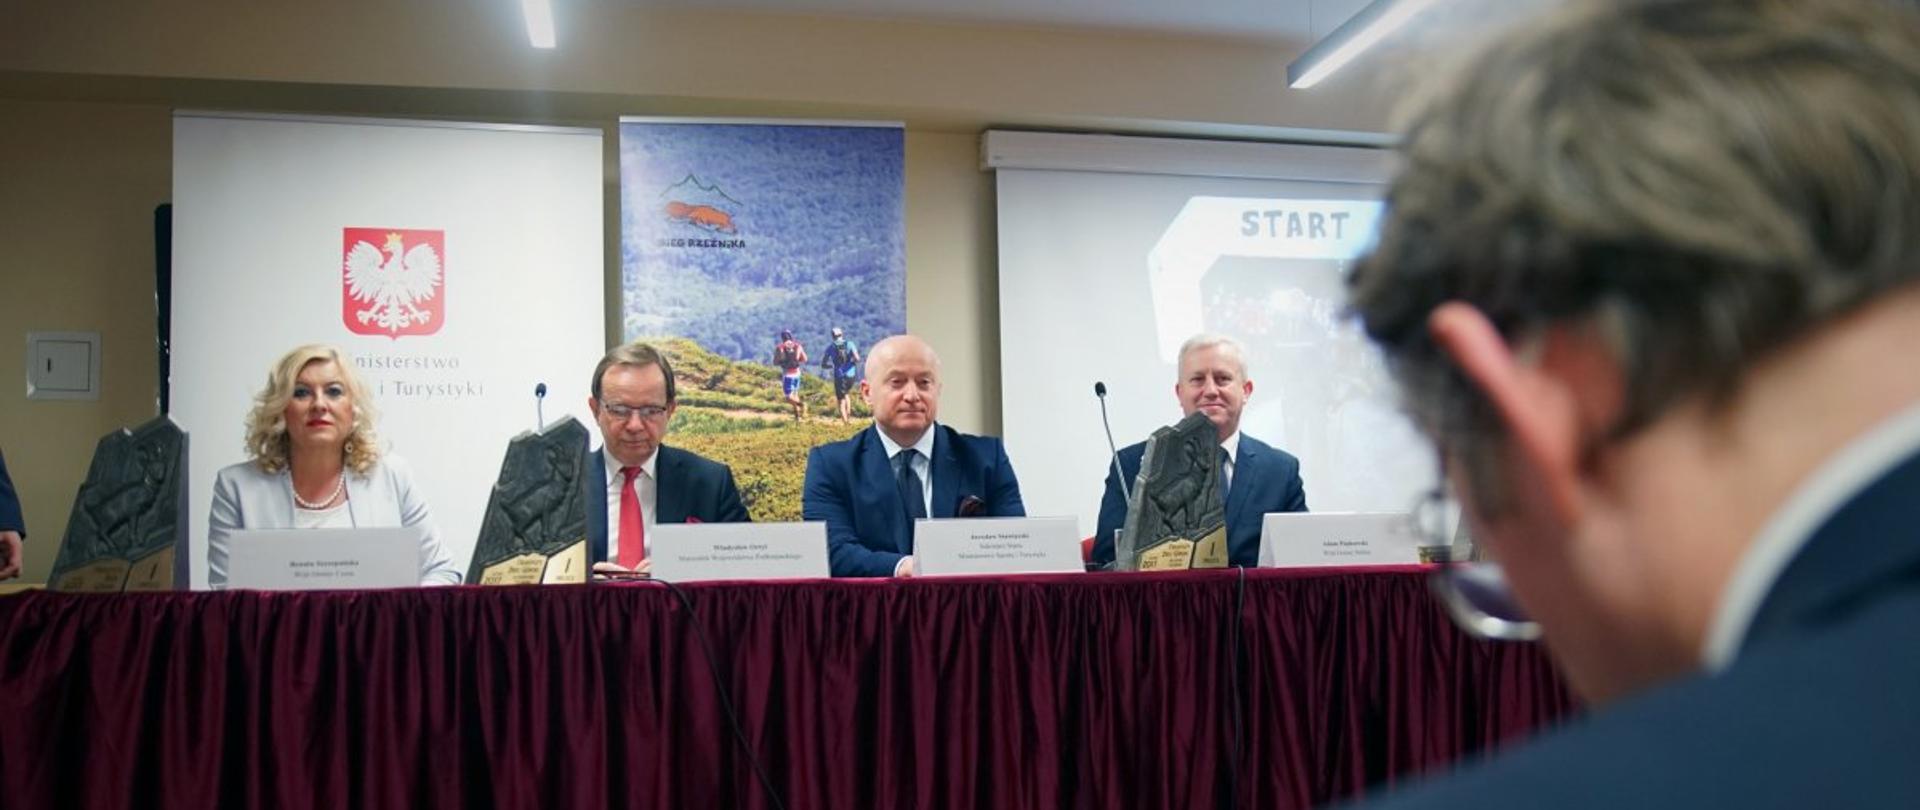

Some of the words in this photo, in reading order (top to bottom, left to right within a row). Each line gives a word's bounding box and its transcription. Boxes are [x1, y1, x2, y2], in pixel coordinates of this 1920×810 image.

[1241, 210, 1350, 239] START
[355, 352, 460, 369] nisterstwo
[394, 380, 485, 400] Turystyki
